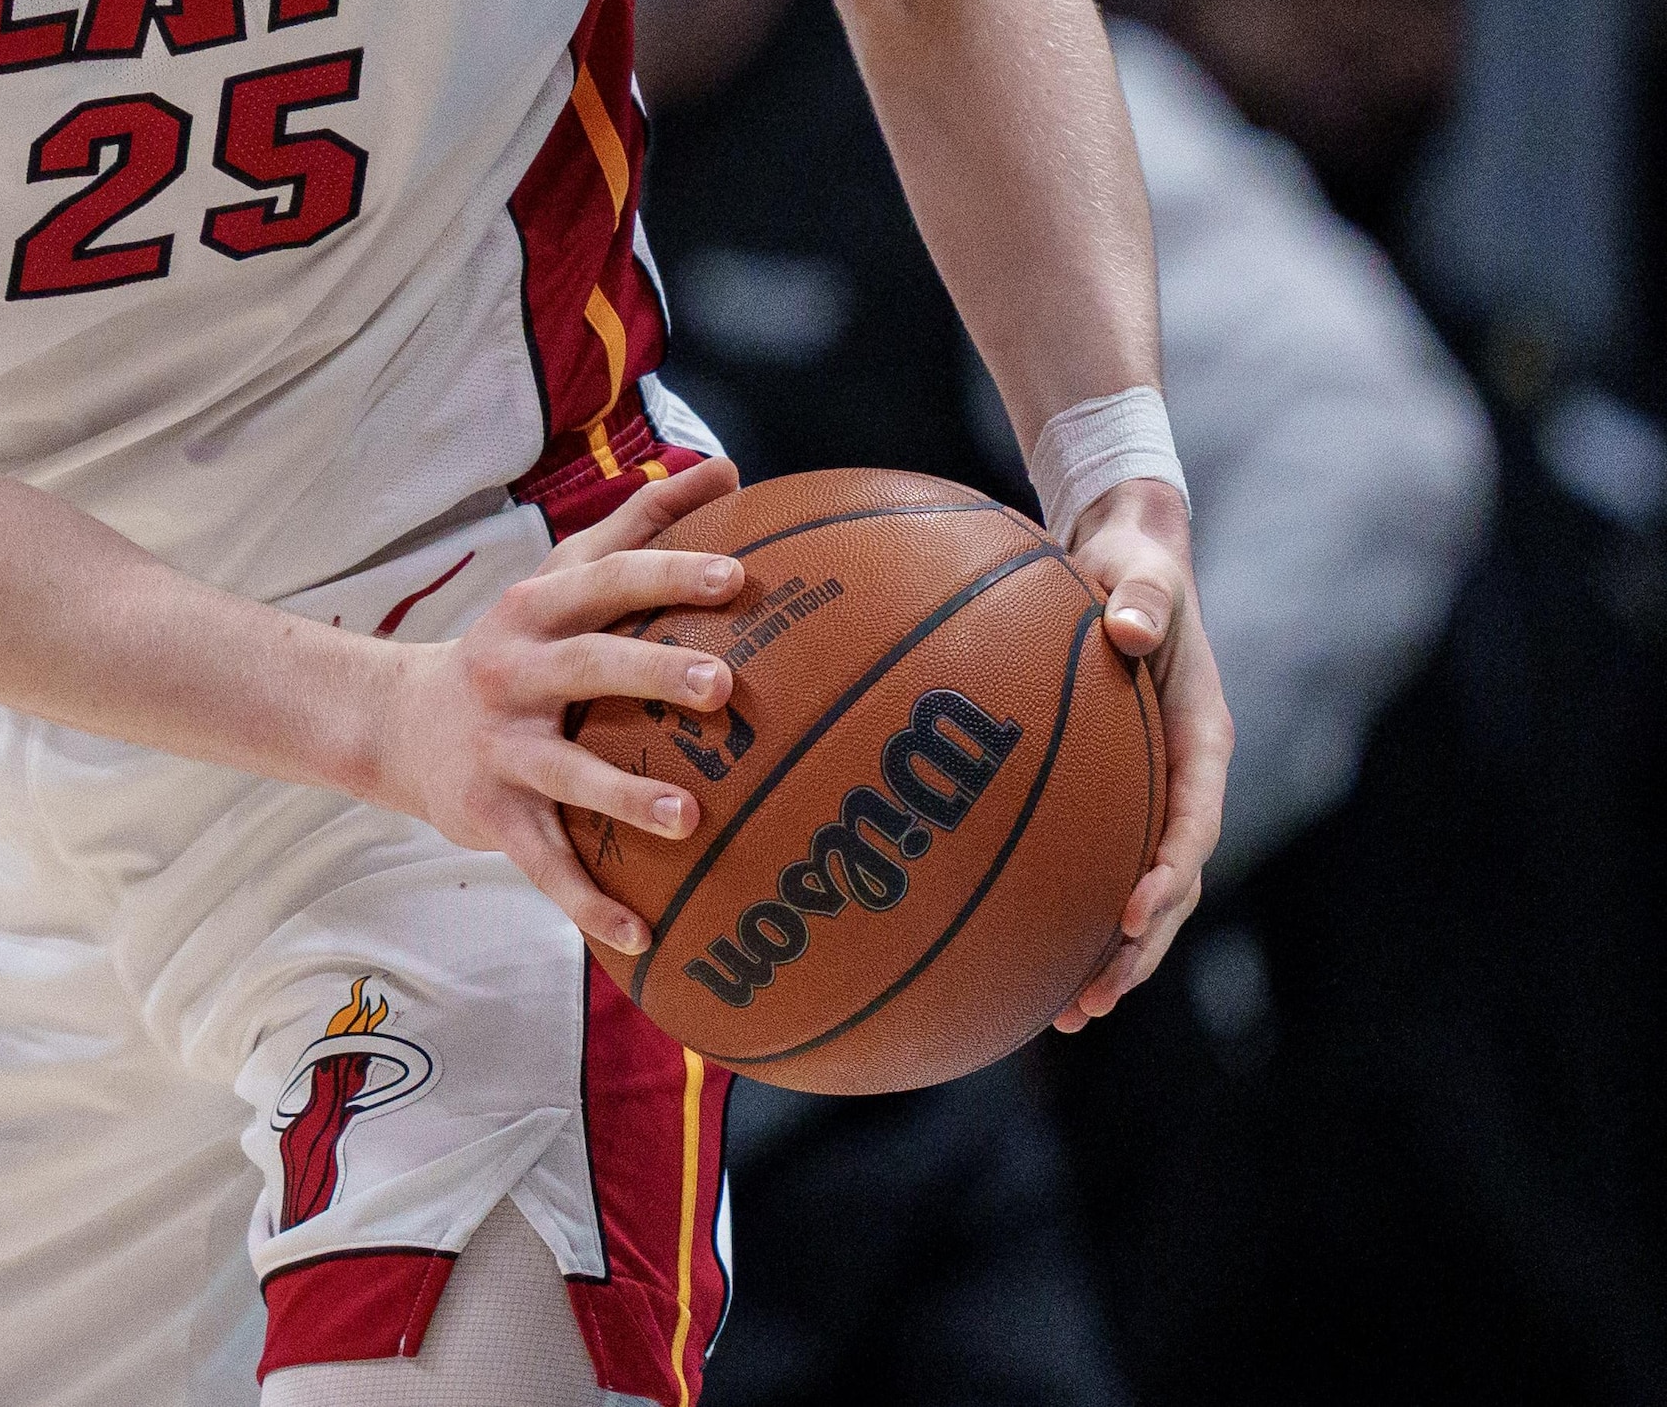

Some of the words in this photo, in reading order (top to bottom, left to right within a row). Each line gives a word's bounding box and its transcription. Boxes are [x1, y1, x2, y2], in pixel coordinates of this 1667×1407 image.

[4, 47, 369, 303] 25
[763, 577, 806, 609] GENUINE
[780, 578, 844, 622] OFFICIAL
[731, 602, 767, 635] LEATHER
[751, 612, 791, 649] GAME
[684, 689, 1024, 1007] Wilson
